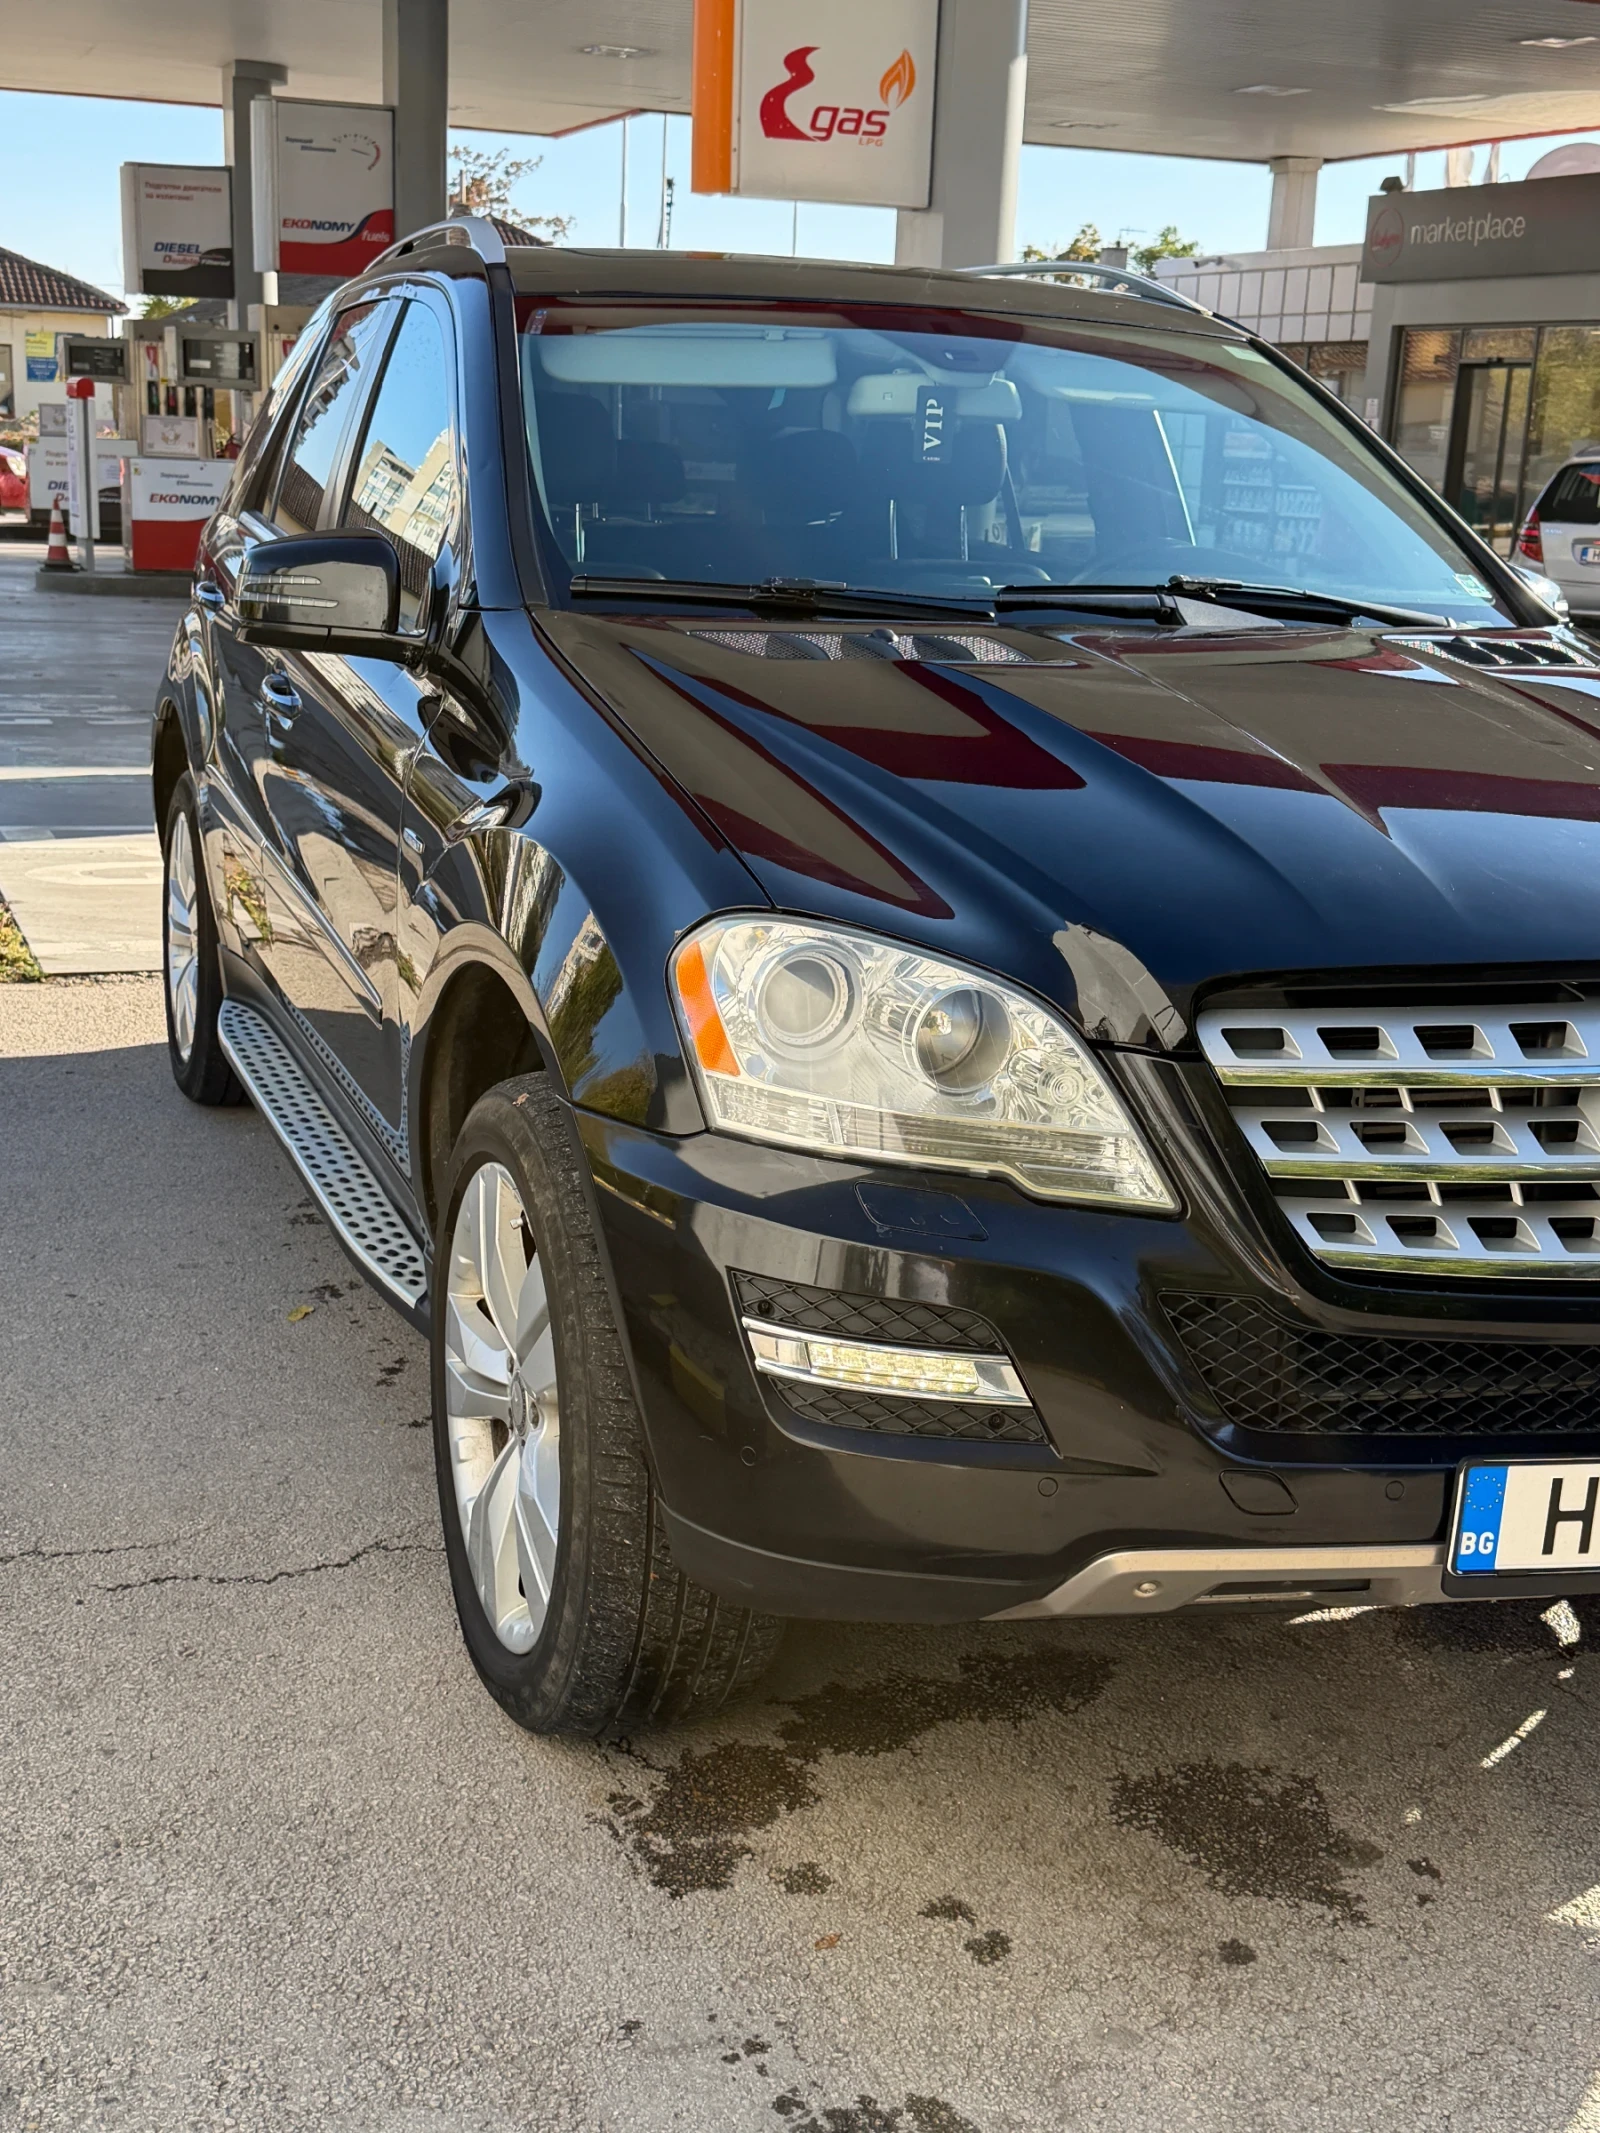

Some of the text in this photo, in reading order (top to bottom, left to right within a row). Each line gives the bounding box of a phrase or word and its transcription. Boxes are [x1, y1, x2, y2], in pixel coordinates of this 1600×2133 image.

[858, 136, 884, 147] LPG
[281, 217, 356, 233] EKONOMY
[1409, 212, 1526, 247] marketplace
[361, 229, 391, 243] fuels
[153, 241, 202, 255] DIESEL
[923, 398, 944, 451] VIP
[47, 480, 69, 491] DIE
[1541, 1476, 1600, 1556] H
[1459, 1531, 1495, 1555] BG
